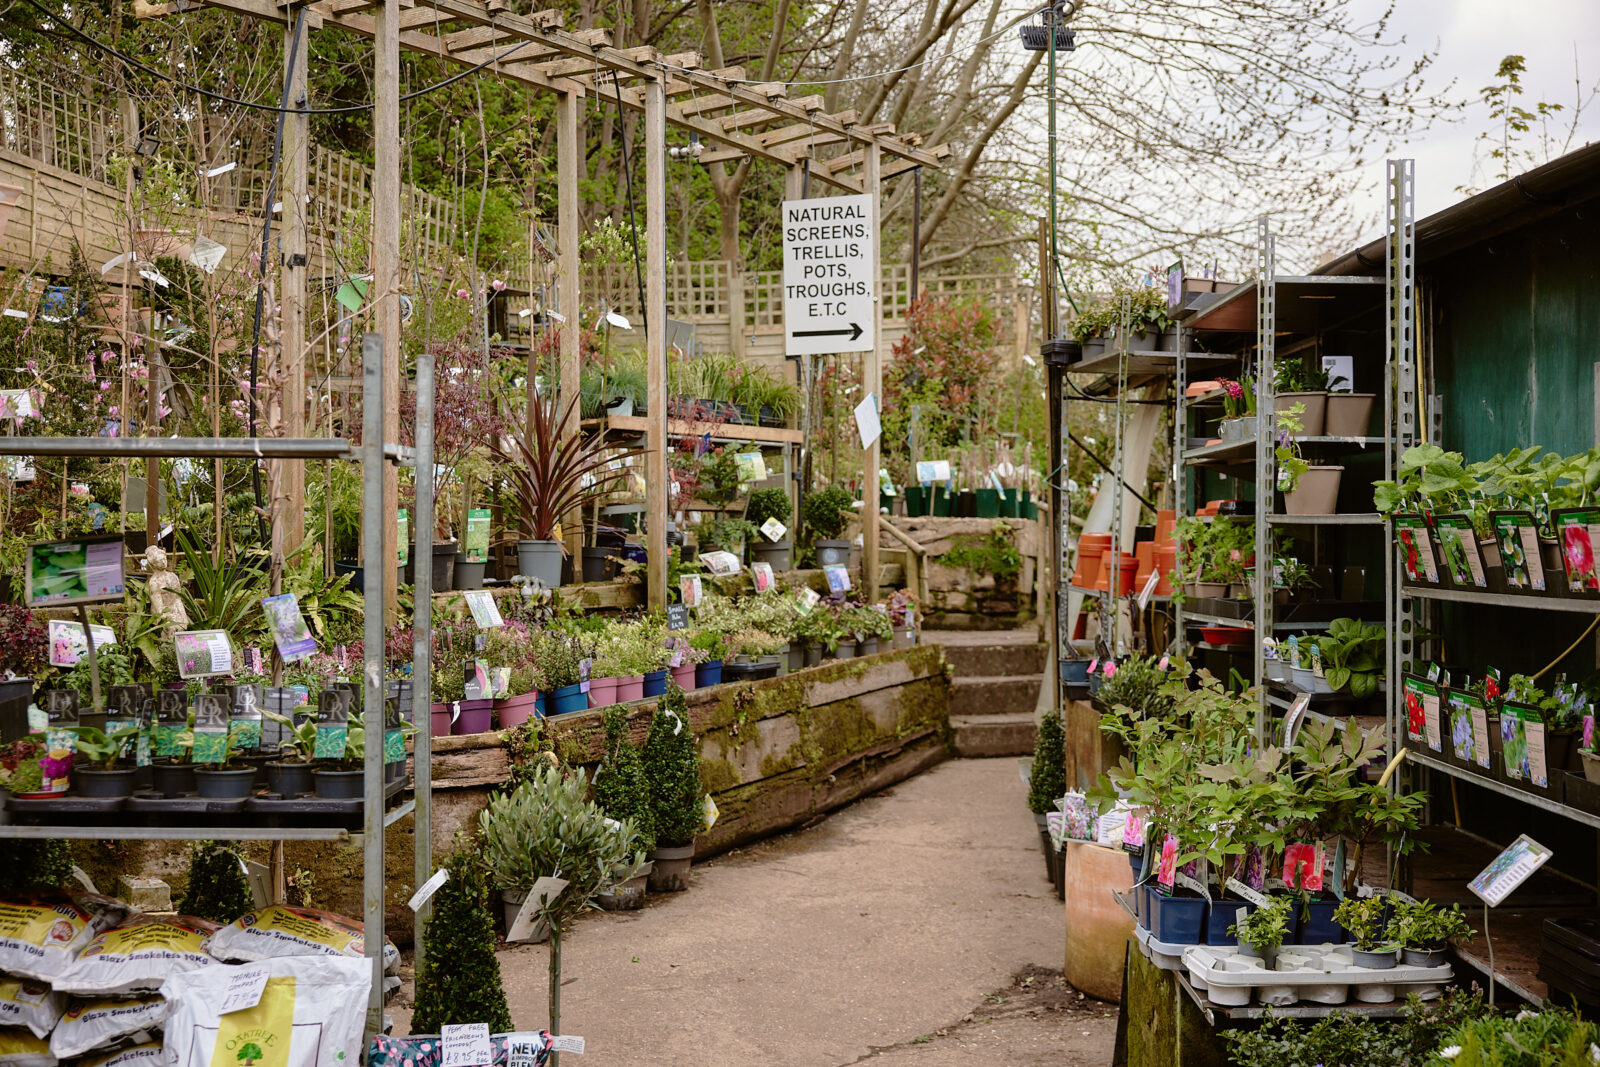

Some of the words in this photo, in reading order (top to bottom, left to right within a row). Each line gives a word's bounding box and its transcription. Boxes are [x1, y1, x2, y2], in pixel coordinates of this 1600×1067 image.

[789, 205, 866, 223] NATURAL
[786, 224, 870, 242] SCREENS,
[792, 243, 864, 261] TRELLIS,
[804, 263, 852, 280] POTS,
[786, 281, 870, 299] TROUGHS,
[808, 302, 847, 317] E.T.C
[128, 951, 181, 961] Smokeless
